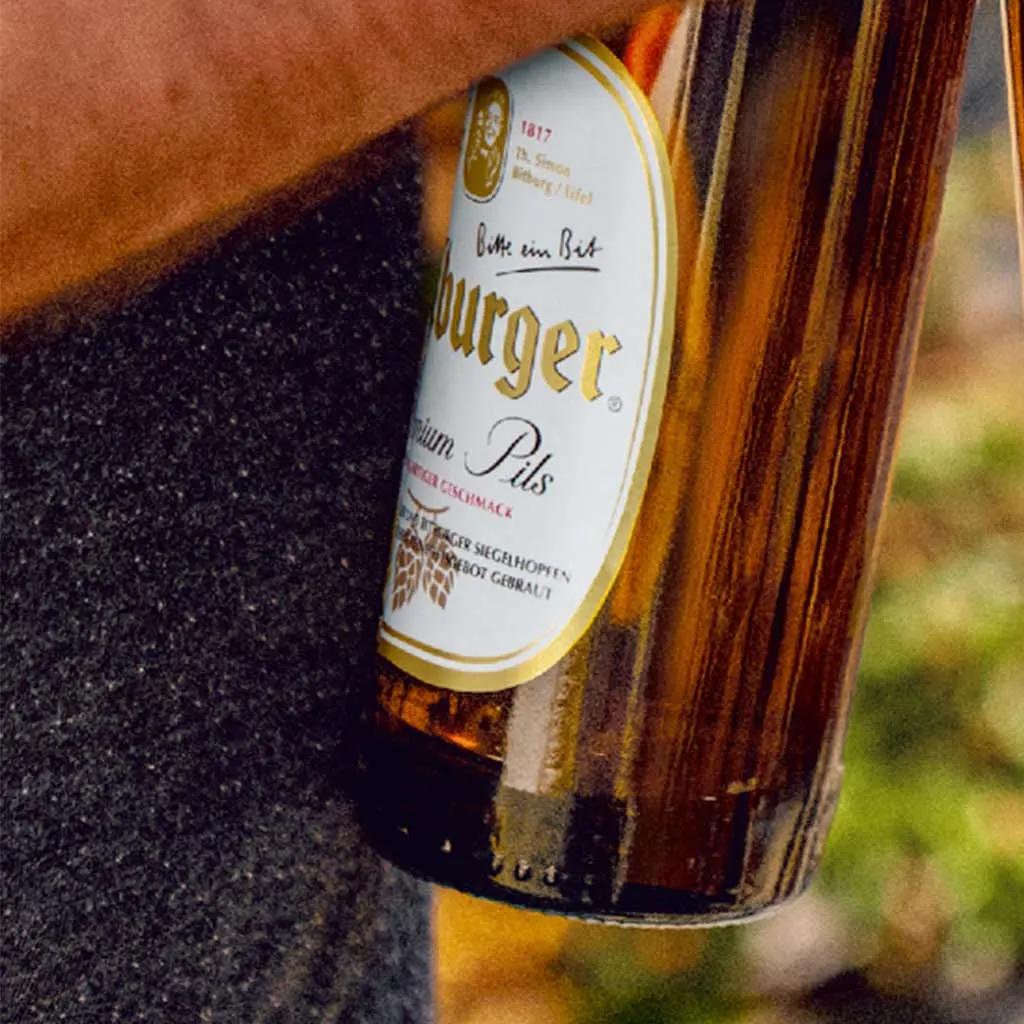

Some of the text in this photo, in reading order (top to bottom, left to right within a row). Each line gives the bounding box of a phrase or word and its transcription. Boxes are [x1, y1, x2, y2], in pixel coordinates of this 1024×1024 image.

[521, 120, 552, 142] 1817
[476, 222, 602, 260] Bitte ein Bit
[464, 416, 554, 496] Pils
[440, 479, 513, 519] GESCHMACK
[474, 542, 572, 583] SIEGELHOPFEN
[490, 571, 552, 600] GEBRAUT
